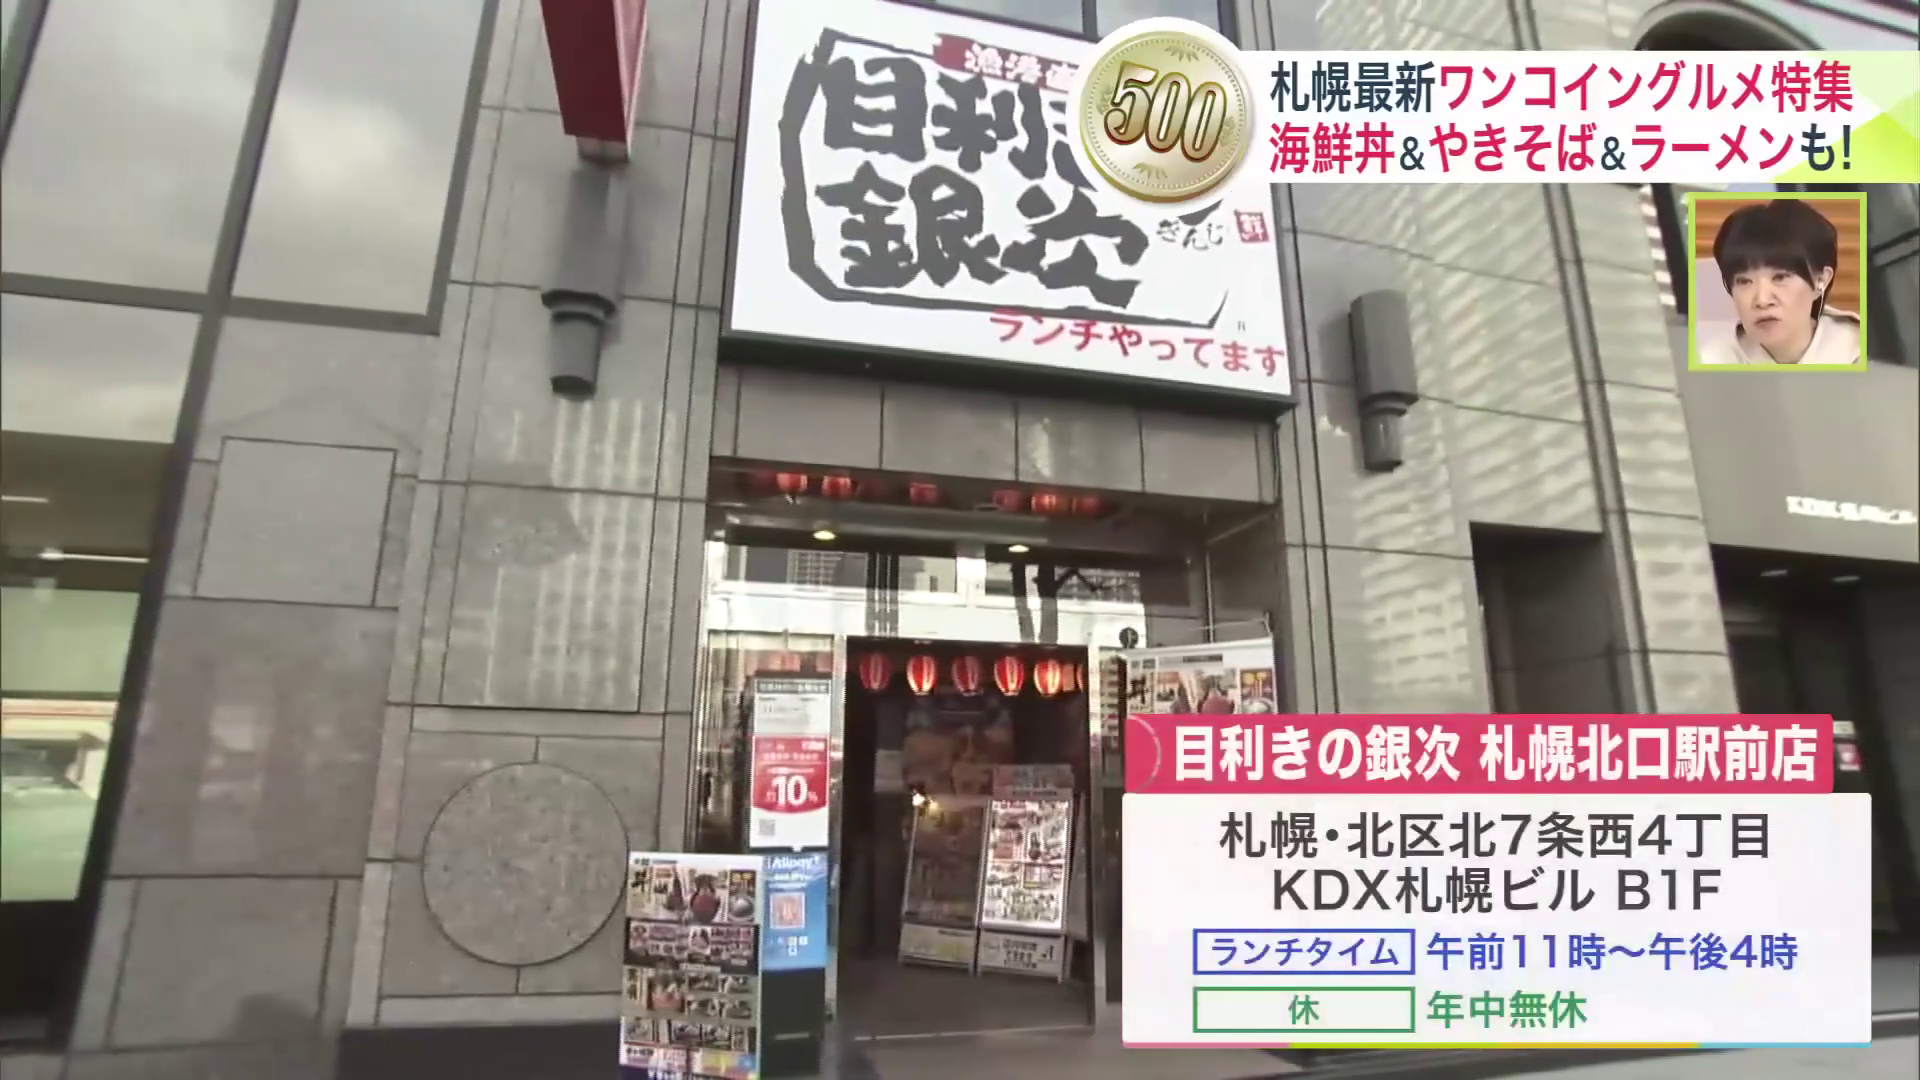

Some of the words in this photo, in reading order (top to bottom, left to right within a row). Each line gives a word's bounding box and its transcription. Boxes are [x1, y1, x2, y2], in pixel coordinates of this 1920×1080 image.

[815, 160, 1149, 309] 銀次
[989, 309, 1285, 377] ランチやってます
